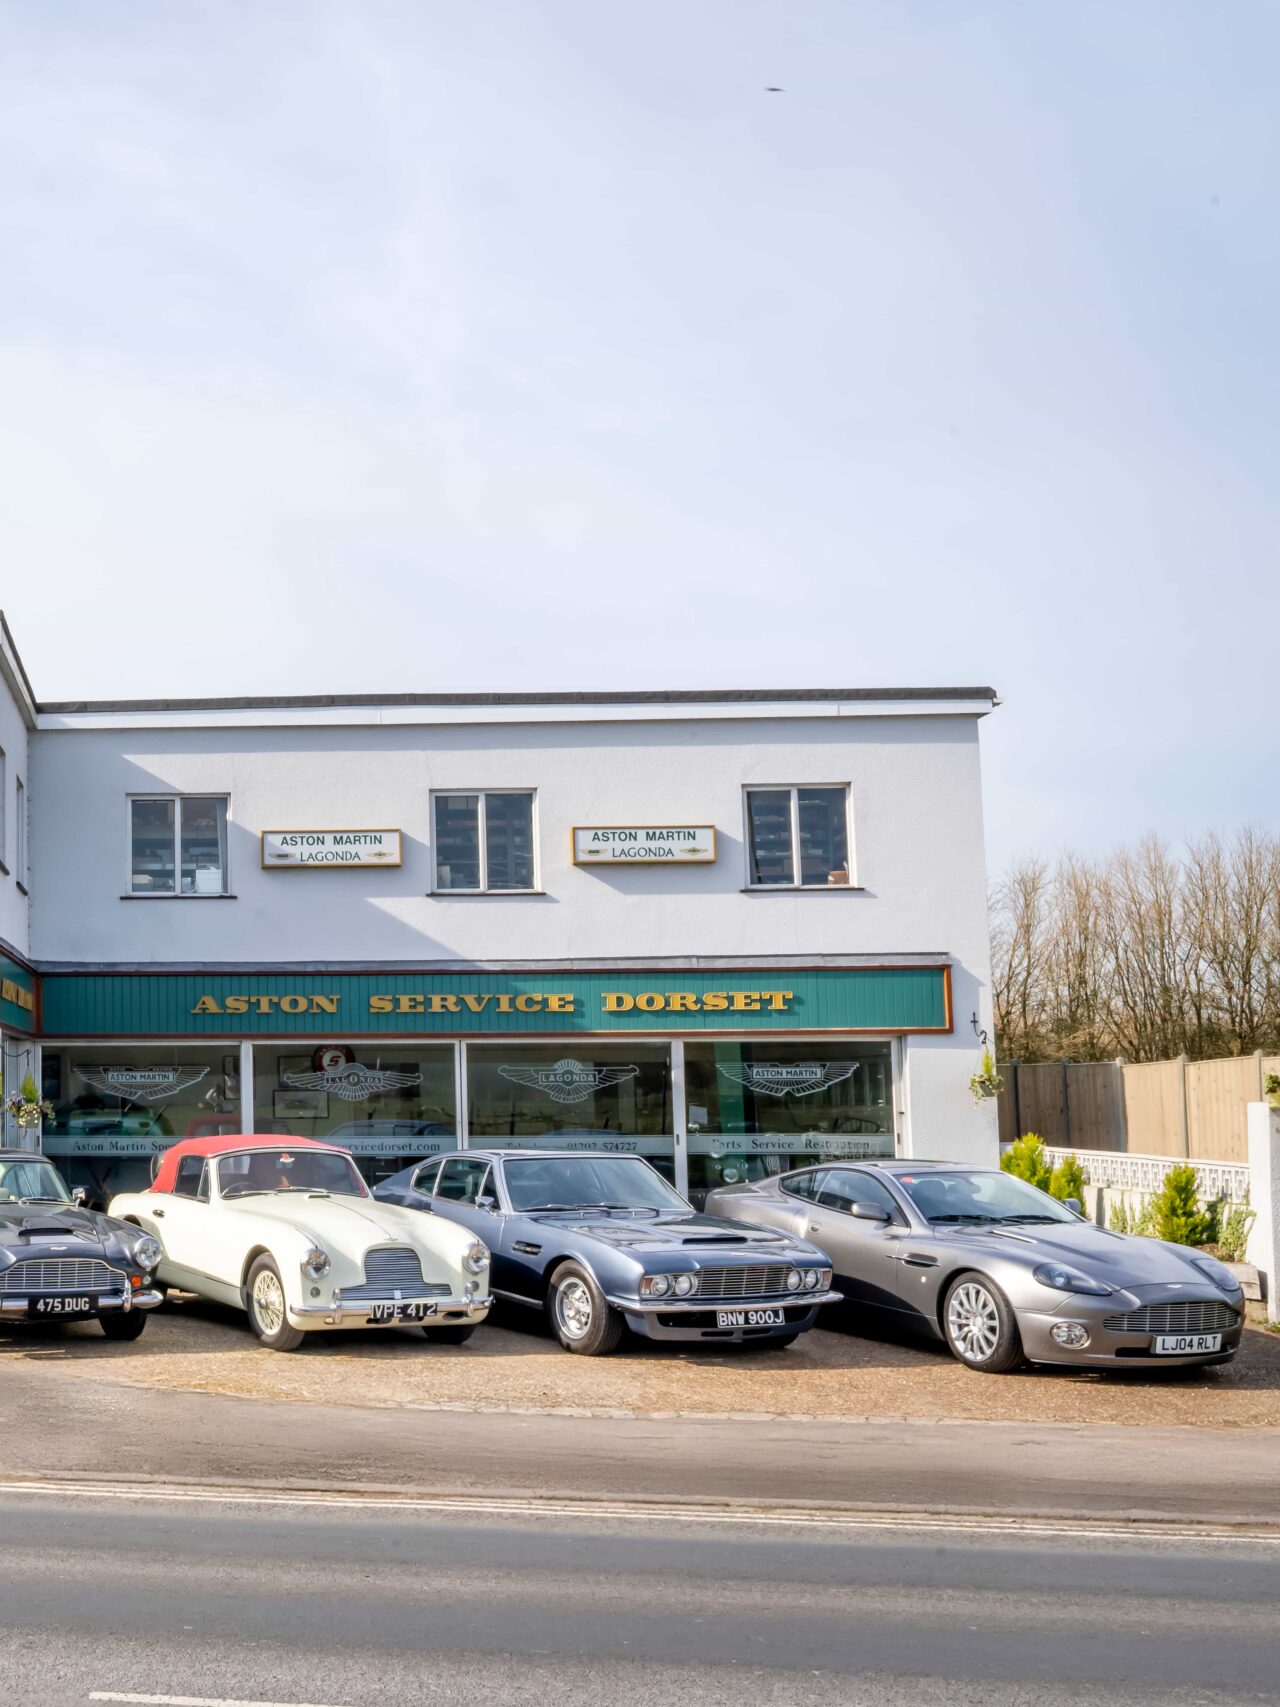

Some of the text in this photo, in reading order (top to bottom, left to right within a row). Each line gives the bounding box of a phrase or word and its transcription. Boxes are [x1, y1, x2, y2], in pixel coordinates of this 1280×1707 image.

[280, 834, 383, 846] ASTON MARTIN
[592, 830, 696, 842] ASTON MARTIN
[300, 851, 361, 862] LAGONDA
[612, 847, 675, 858] LAGONDA
[190, 991, 794, 1014] ASTON SERVICE DORSET
[327, 1074, 380, 1084] LAGONDA
[542, 1073, 595, 1081] LAGONDA
[73, 1141, 104, 1151] Aston
[109, 1141, 146, 1151] Martin
[602, 1142, 638, 1151] 574727
[751, 1138, 794, 1149] Service
[37, 1297, 90, 1312] 475 DUG
[407, 1303, 436, 1317] 412
[720, 1310, 783, 1326] BNW 900J
[1161, 1336, 1218, 1351] LJ04 RLT
